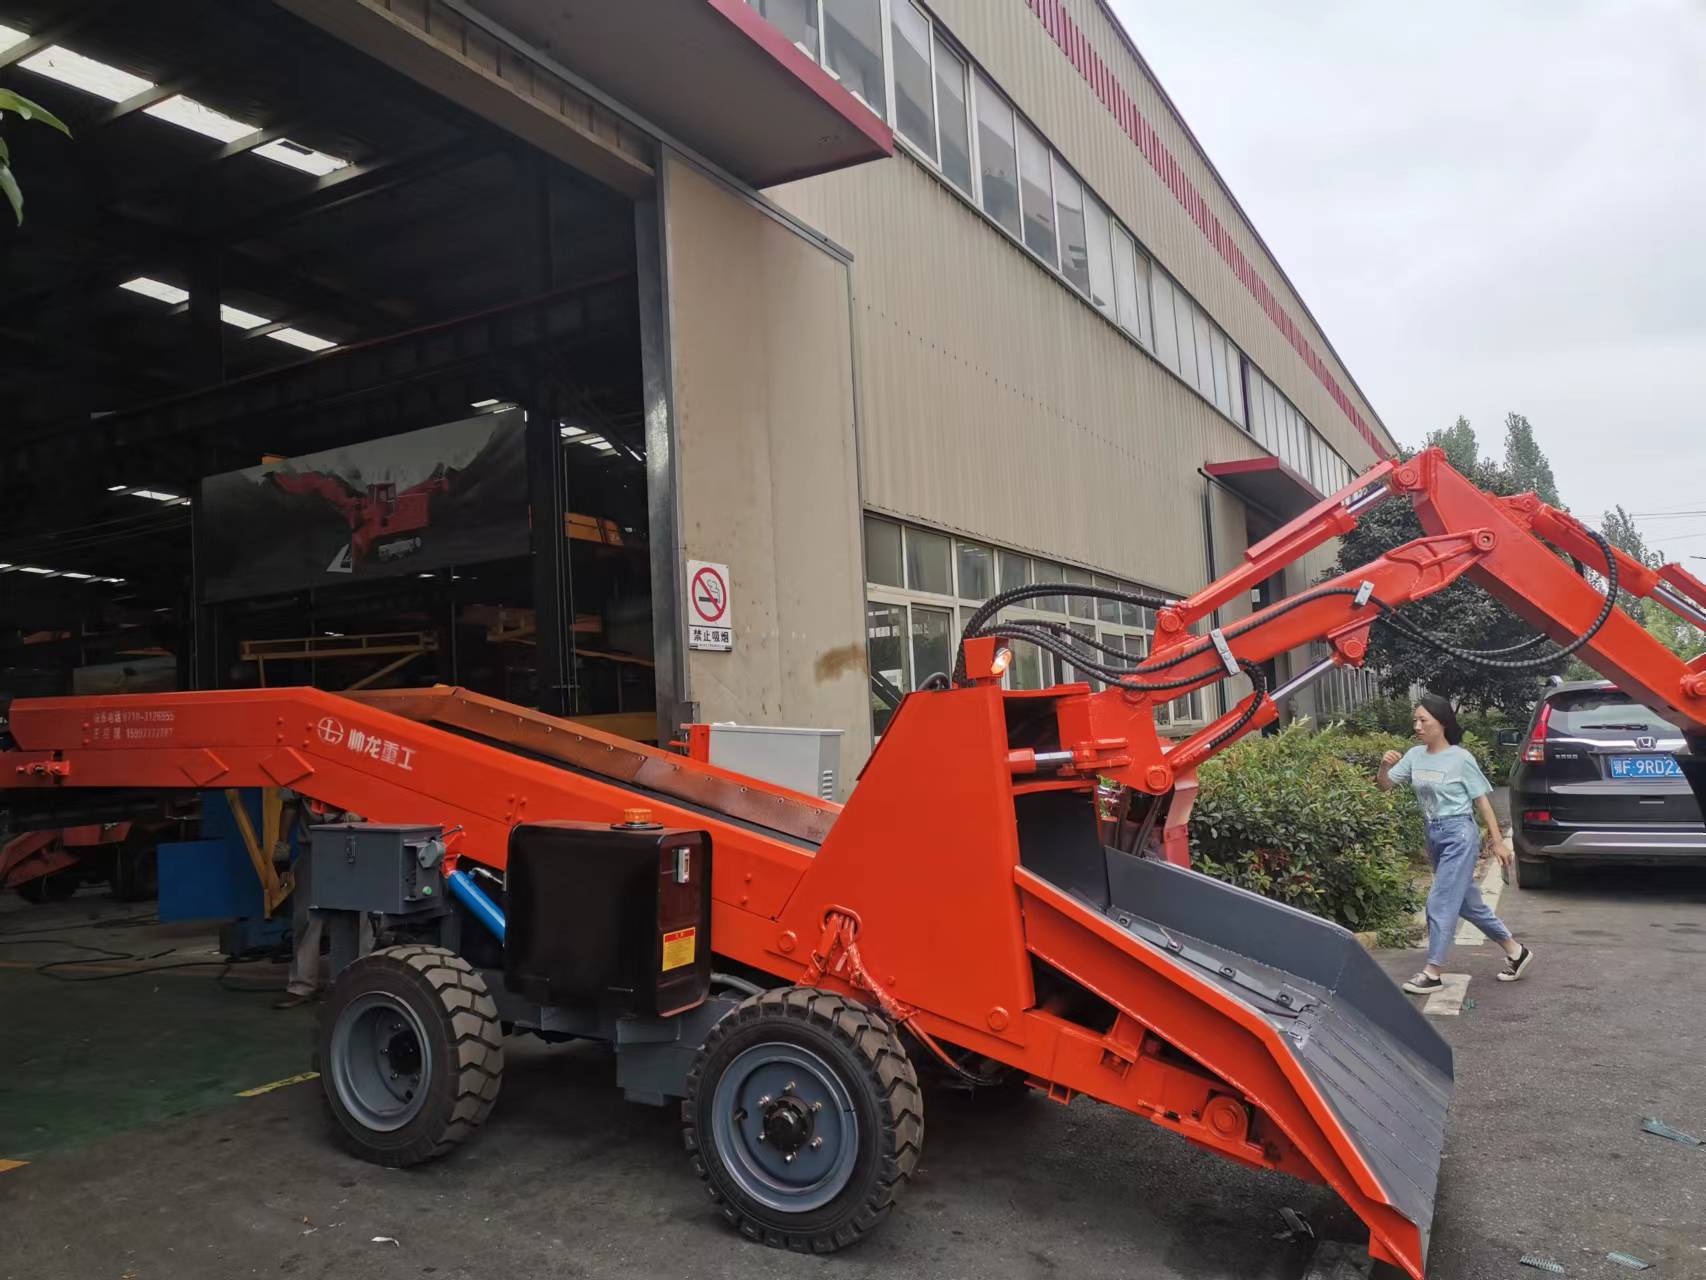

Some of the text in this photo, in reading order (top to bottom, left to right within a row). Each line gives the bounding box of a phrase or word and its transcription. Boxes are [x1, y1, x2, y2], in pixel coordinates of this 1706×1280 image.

[694, 628, 729, 643] 禁止吸烟
[347, 728, 416, 771] 帅龙重工
